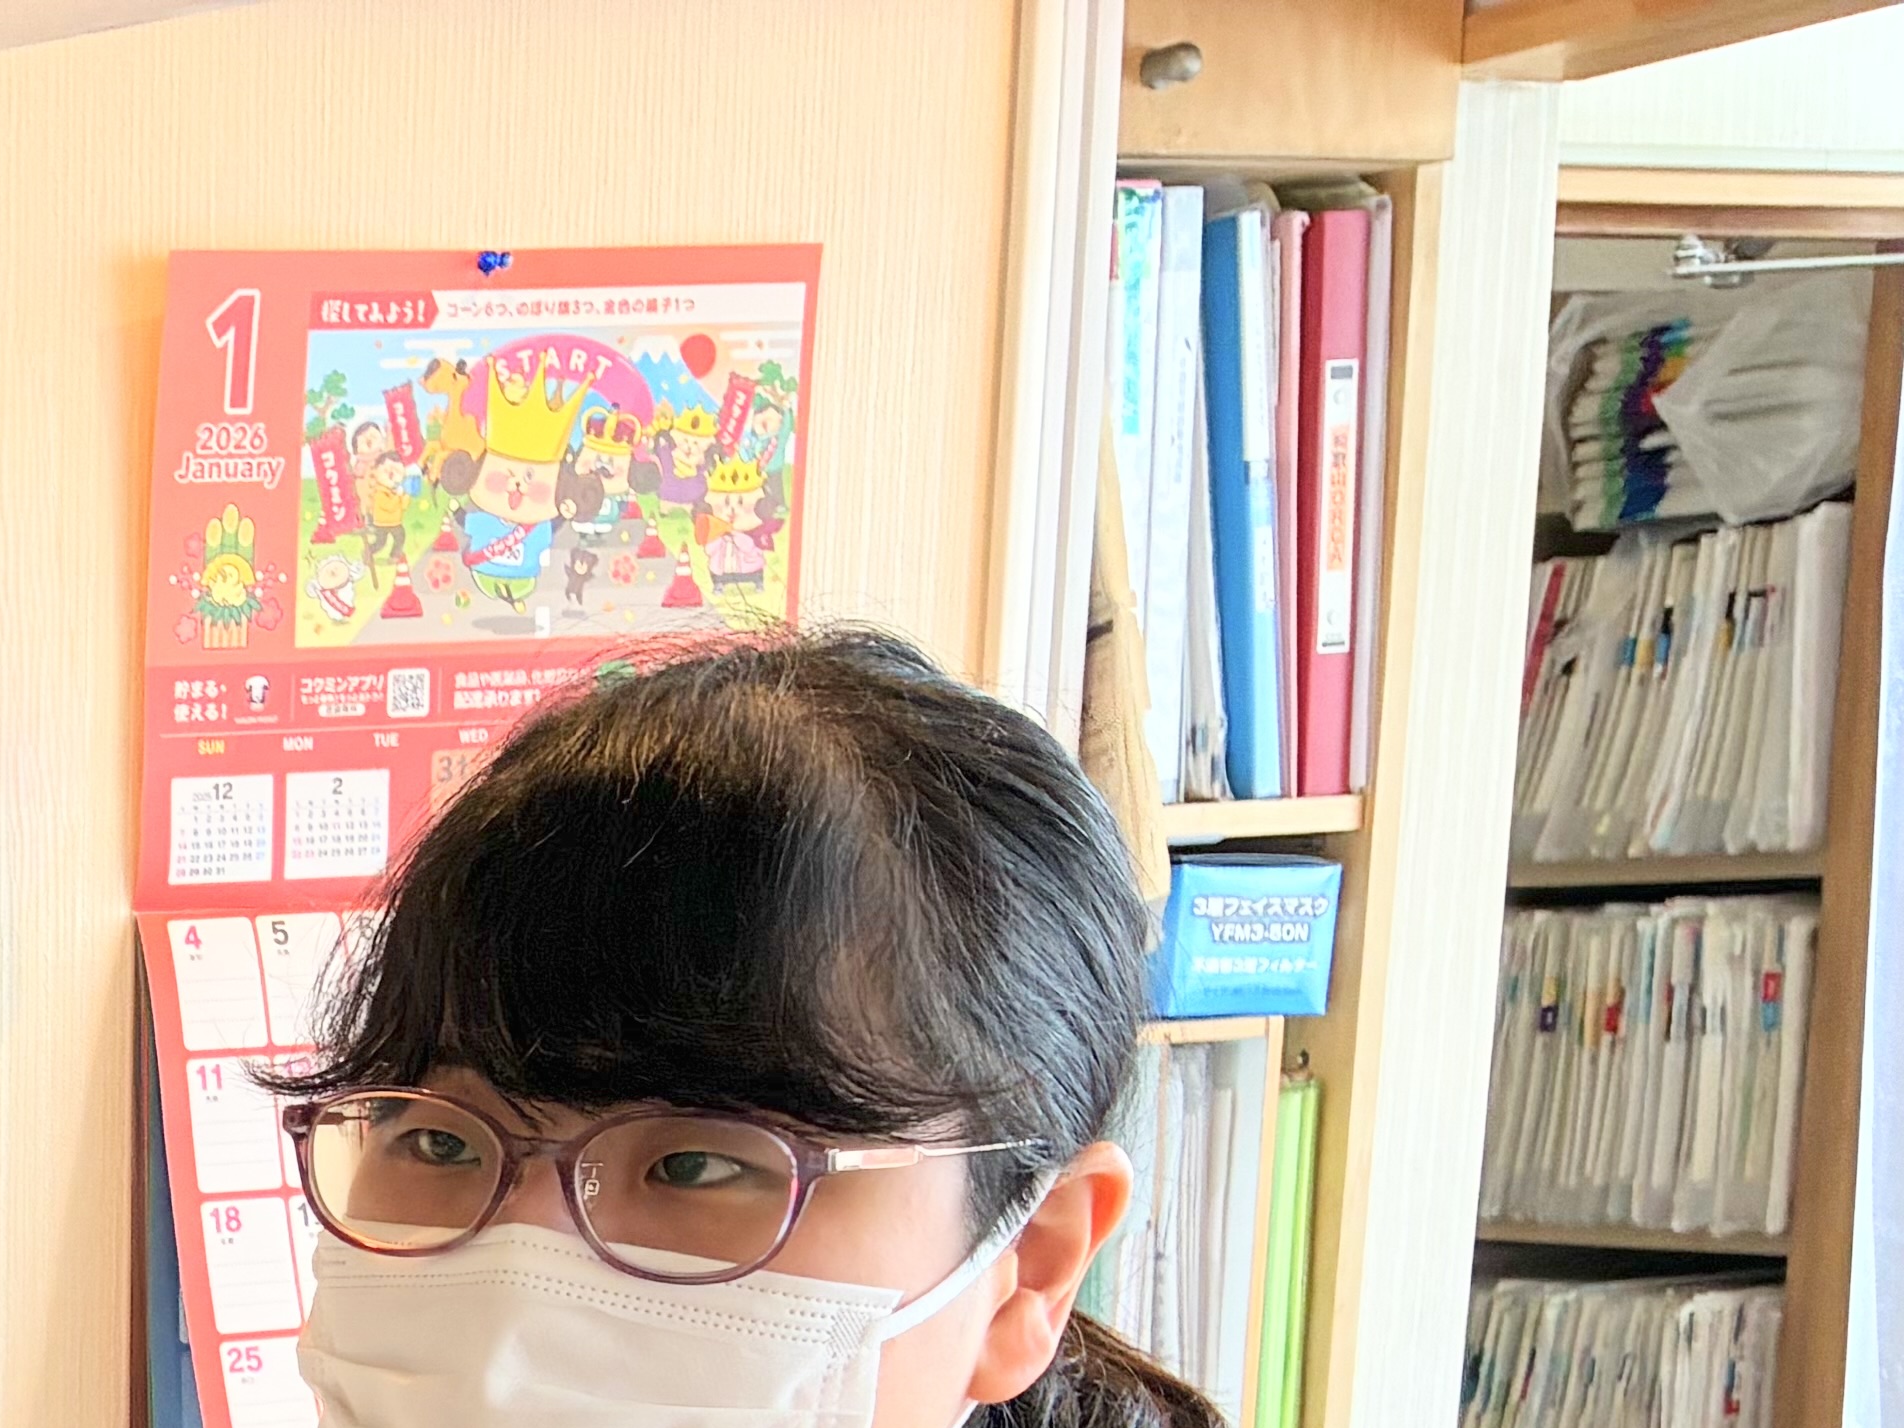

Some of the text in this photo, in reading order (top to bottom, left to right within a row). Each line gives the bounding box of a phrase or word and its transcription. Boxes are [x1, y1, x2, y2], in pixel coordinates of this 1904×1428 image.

[205, 288, 261, 415] 1
[496, 347, 613, 383] START
[196, 422, 269, 454] 2026
[174, 452, 285, 489] January
[198, 727, 488, 755] SUN MON TUE WED
[213, 782, 233, 800] 12
[332, 777, 343, 795] 2
[184, 924, 203, 949] 4
[271, 920, 289, 945] 5
[196, 1063, 223, 1091] 11
[209, 1205, 243, 1234] 18
[226, 1346, 264, 1374] 25
